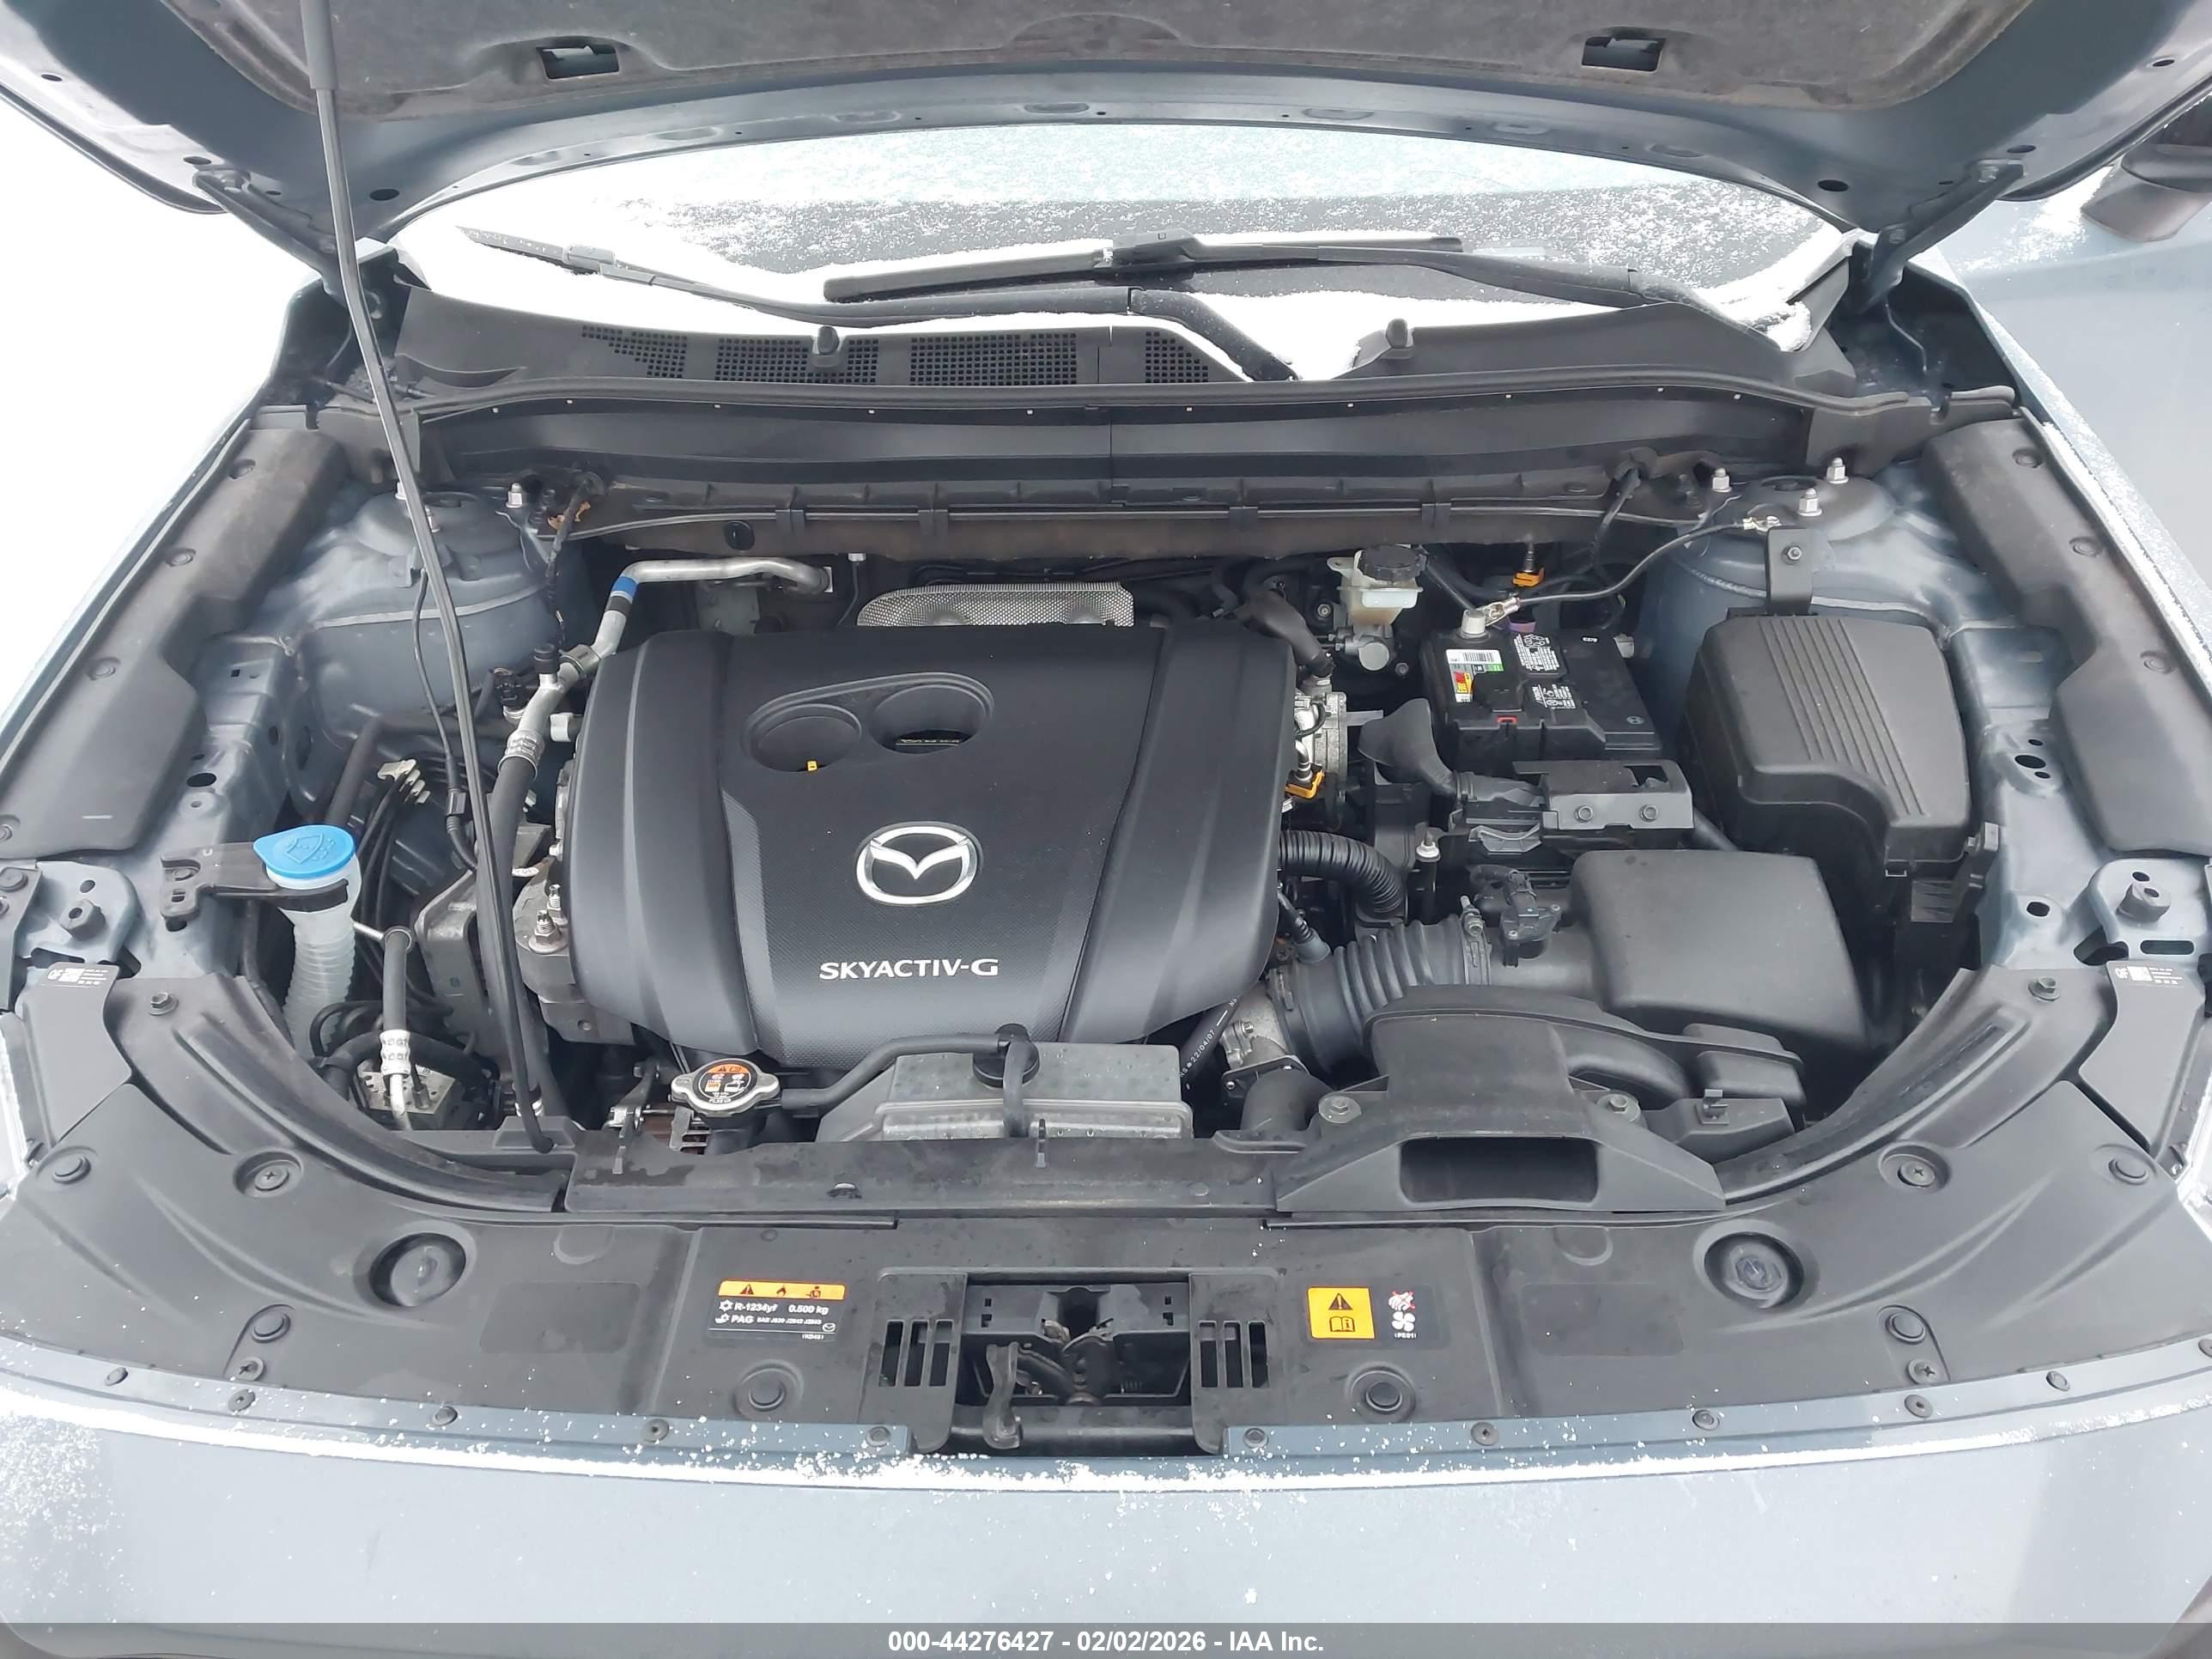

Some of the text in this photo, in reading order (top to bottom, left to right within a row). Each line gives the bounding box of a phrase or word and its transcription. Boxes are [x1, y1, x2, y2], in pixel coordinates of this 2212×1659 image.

[819, 958, 999, 980] SKYACTIV-G
[1190, 1029, 1215, 1063] 22/04/07
[734, 1302, 829, 1315] R-1234yf 0.500 kg
[731, 1315, 754, 1323] PAG
